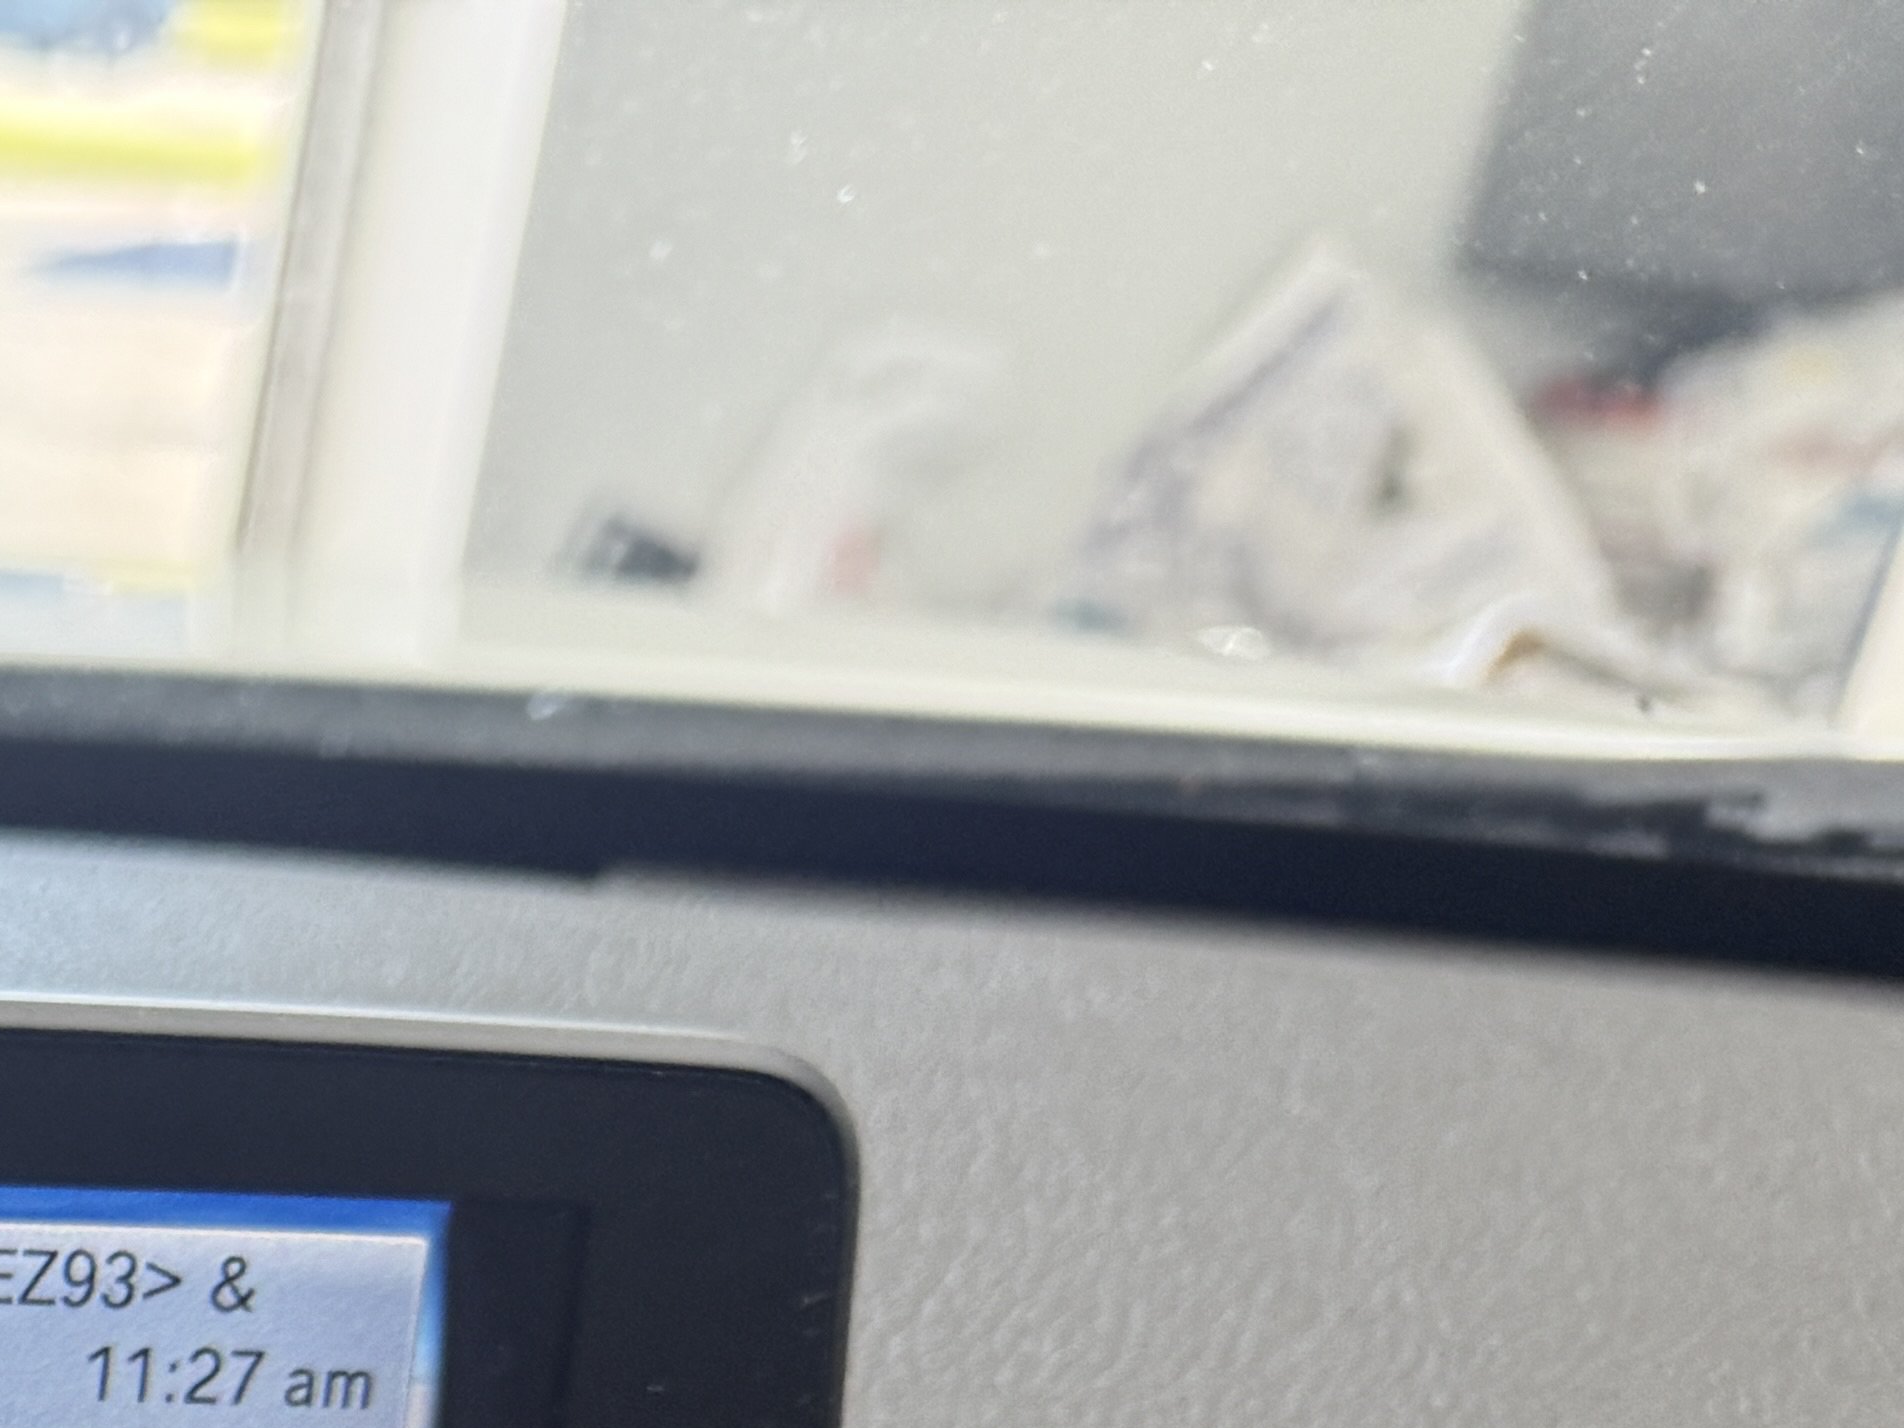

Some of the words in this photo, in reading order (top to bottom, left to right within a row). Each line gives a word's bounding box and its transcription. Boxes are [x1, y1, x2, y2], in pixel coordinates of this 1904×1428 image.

[208, 1255, 257, 1314] &
[87, 1345, 265, 1405] 11:27
[283, 1364, 373, 1410] am
